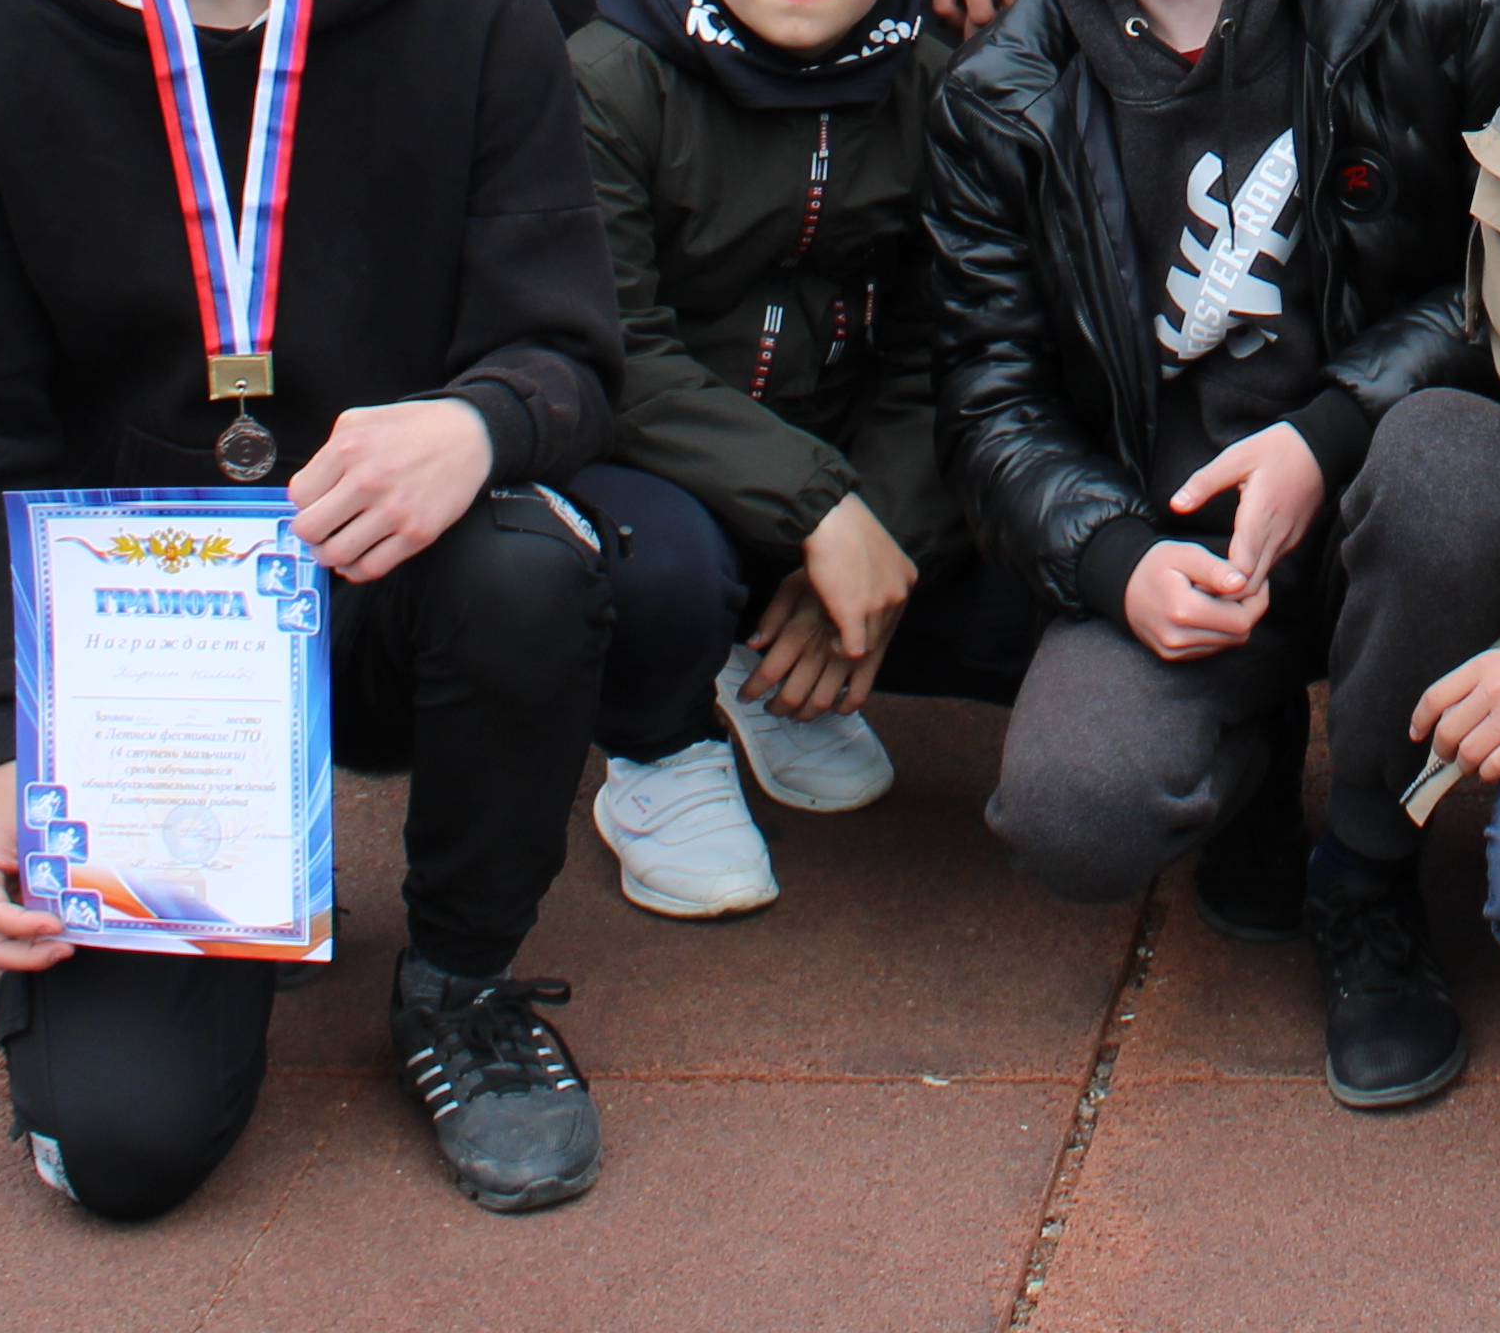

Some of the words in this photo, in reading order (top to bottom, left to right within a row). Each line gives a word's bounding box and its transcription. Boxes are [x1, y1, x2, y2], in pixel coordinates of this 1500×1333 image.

[1187, 237, 1251, 354] FASTER
[93, 587, 252, 620] ГРАМОТА
[86, 633, 266, 654] Награждается
[226, 716, 261, 724] место
[104, 728, 156, 740] Летнем
[160, 728, 229, 743] фестивале
[232, 730, 261, 742] ГТО
[126, 749, 179, 760] ступень
[181, 750, 246, 761] мальчики)
[125, 765, 156, 776] среди
